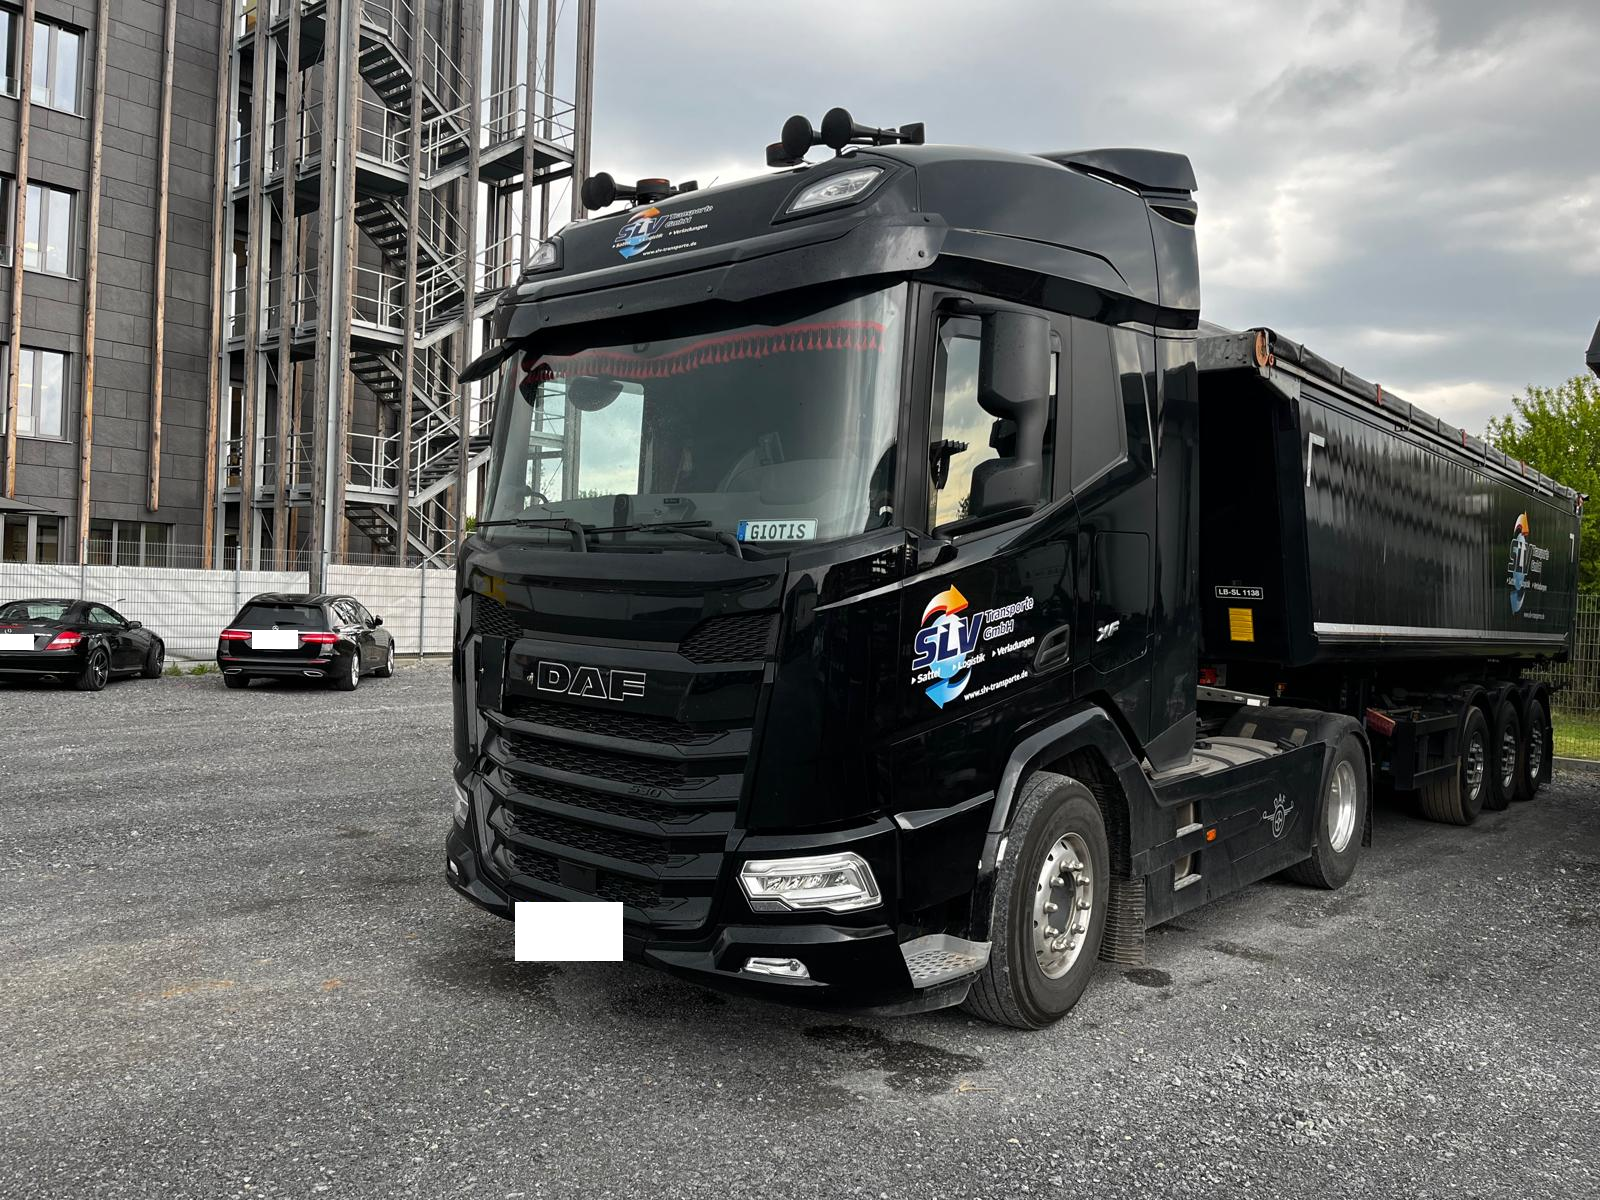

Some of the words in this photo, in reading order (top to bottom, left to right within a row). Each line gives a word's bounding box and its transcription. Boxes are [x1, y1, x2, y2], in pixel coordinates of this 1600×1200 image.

[668, 205, 714, 220] Transporte
[615, 215, 670, 243] SLV
[673, 224, 708, 235] Verladungen
[750, 523, 806, 540] GIOTIS
[1218, 588, 1241, 596] LB-SL
[1242, 589, 1260, 597] 1138
[984, 596, 1034, 623] Transporte
[912, 612, 984, 671] SLV
[983, 619, 1015, 641] GmbH
[957, 653, 986, 670] Logistik
[997, 636, 1035, 657] Verladungen
[537, 661, 646, 701] DAF
[963, 669, 1029, 701] www.slv-transporte.de
